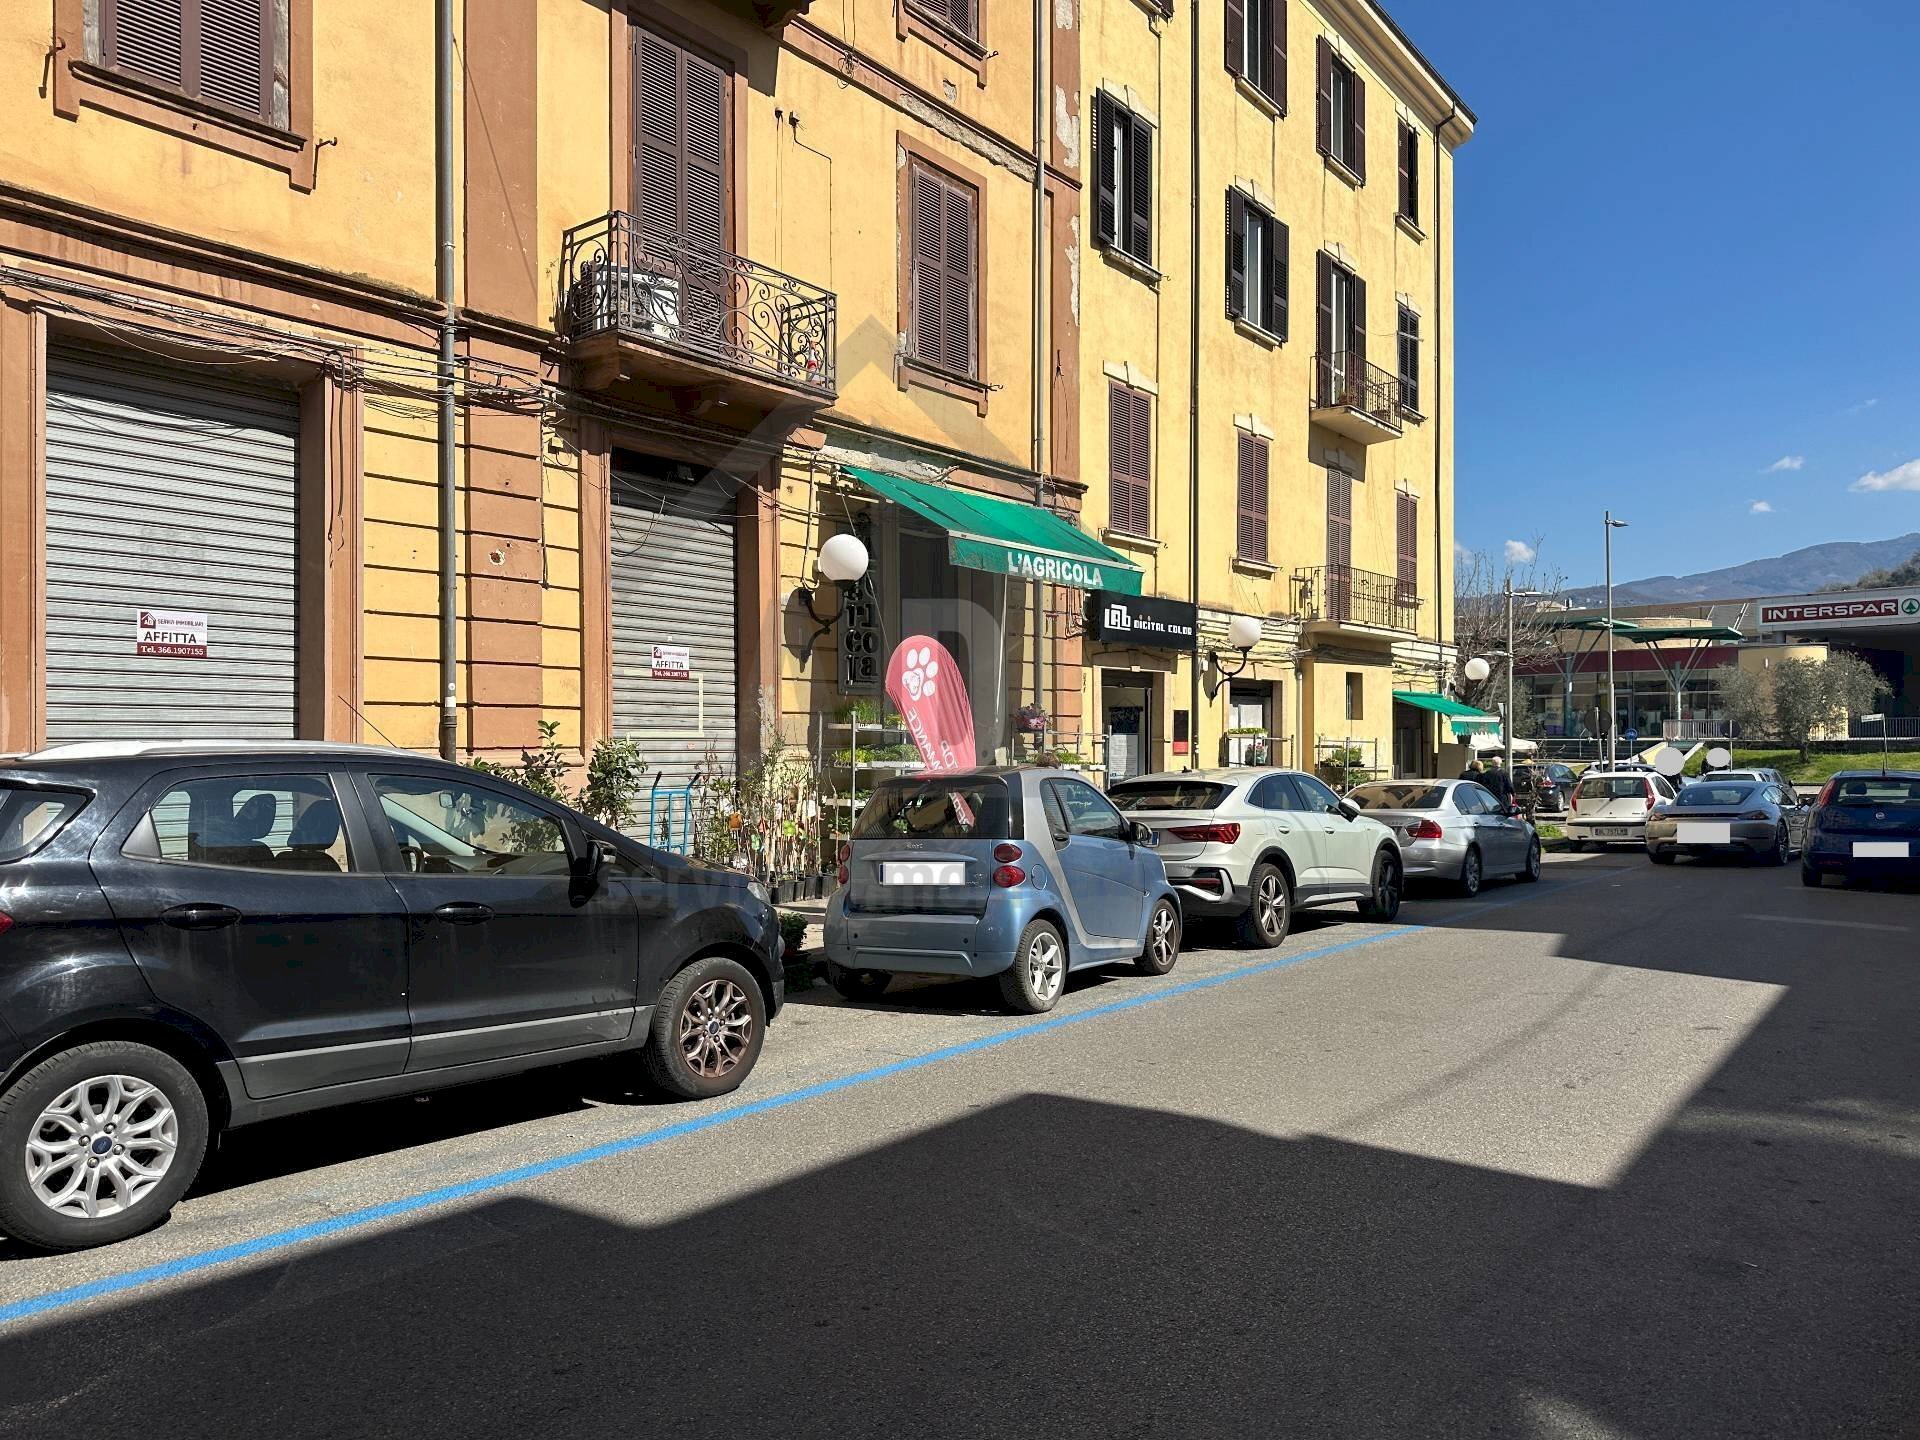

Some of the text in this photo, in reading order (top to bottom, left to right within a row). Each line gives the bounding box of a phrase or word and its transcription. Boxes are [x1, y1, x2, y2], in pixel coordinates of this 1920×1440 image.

[1007, 551, 1104, 587] L'AGRICOLA
[1768, 602, 1896, 620] INTERSPAR
[144, 632, 196, 644] AFFITTA
[656, 660, 683, 668] AFFITTA
